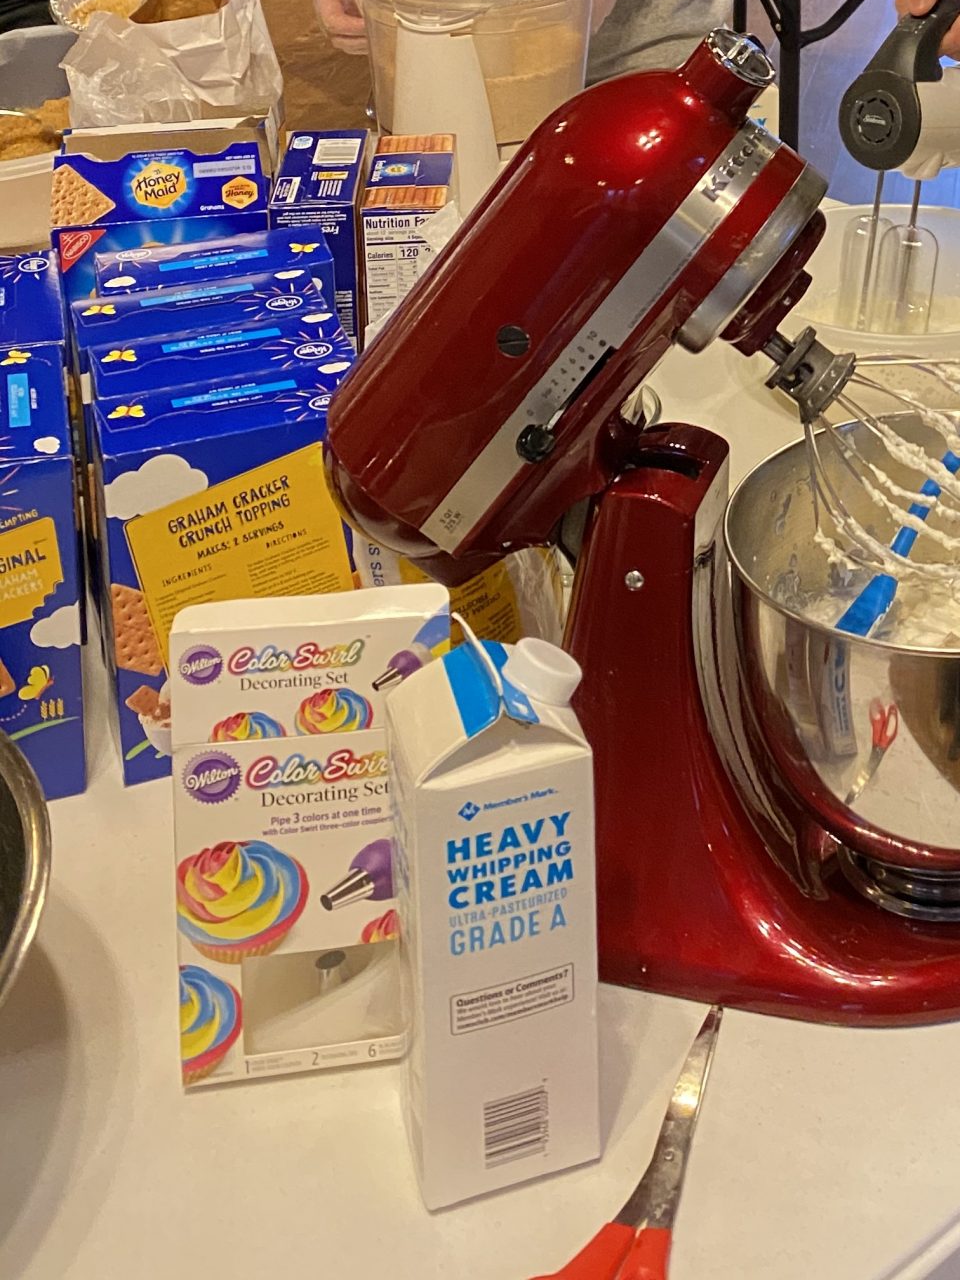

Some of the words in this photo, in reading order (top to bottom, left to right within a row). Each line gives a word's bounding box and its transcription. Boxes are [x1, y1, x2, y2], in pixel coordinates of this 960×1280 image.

[135, 172, 181, 192] Honey
[143, 183, 178, 201] Maid
[225, 189, 254, 199] Honey
[321, 225, 340, 235] Fres
[366, 217, 410, 229] Nutrition
[401, 248, 419, 258] 120
[299, 345, 328, 357] Kroger
[168, 502, 228, 534] GRAHAM
[232, 475, 290, 508] CRACKER
[179, 518, 233, 548] CRUNCH
[236, 493, 291, 526] TOPPING
[197, 540, 231, 560] MAKES:
[233, 537, 240, 546] 2
[242, 520, 285, 544] SERVINGS
[265, 528, 308, 549] DIRECTIONS
[161, 563, 213, 588] INGREDIENTS
[181, 656, 222, 675] Wilton
[229, 648, 291, 674] Color
[293, 641, 363, 669] Swirl
[240, 674, 322, 691] Decorating
[326, 672, 348, 684] Set
[185, 767, 239, 790] Wilton
[248, 756, 319, 787] Color
[323, 750, 388, 781] Swir
[261, 785, 359, 807] Decorating
[363, 781, 389, 796] Set
[483, 793, 528, 811] Member's
[270, 816, 291, 826] Pipe
[293, 812, 300, 823] 3
[302, 812, 330, 823] colors
[331, 811, 340, 819] at
[342, 810, 360, 818] one
[361, 806, 382, 816] time
[262, 828, 279, 836] with
[279, 826, 299, 835] Color
[300, 824, 318, 833] Swirl
[319, 820, 360, 831] three-color
[447, 811, 571, 864] HEAVY
[447, 841, 572, 884] WHIPPING
[448, 859, 574, 909] CREAM
[449, 887, 568, 928] ULTRA-PASTEURIZED
[450, 910, 541, 956] GRADE
[550, 903, 567, 931] A
[456, 990, 503, 1007] Questions
[504, 987, 514, 996] or
[515, 968, 569, 992] Comments?
[312, 1051, 319, 1066] 2
[368, 1044, 377, 1058] 6
[244, 1060, 250, 1074] 1
